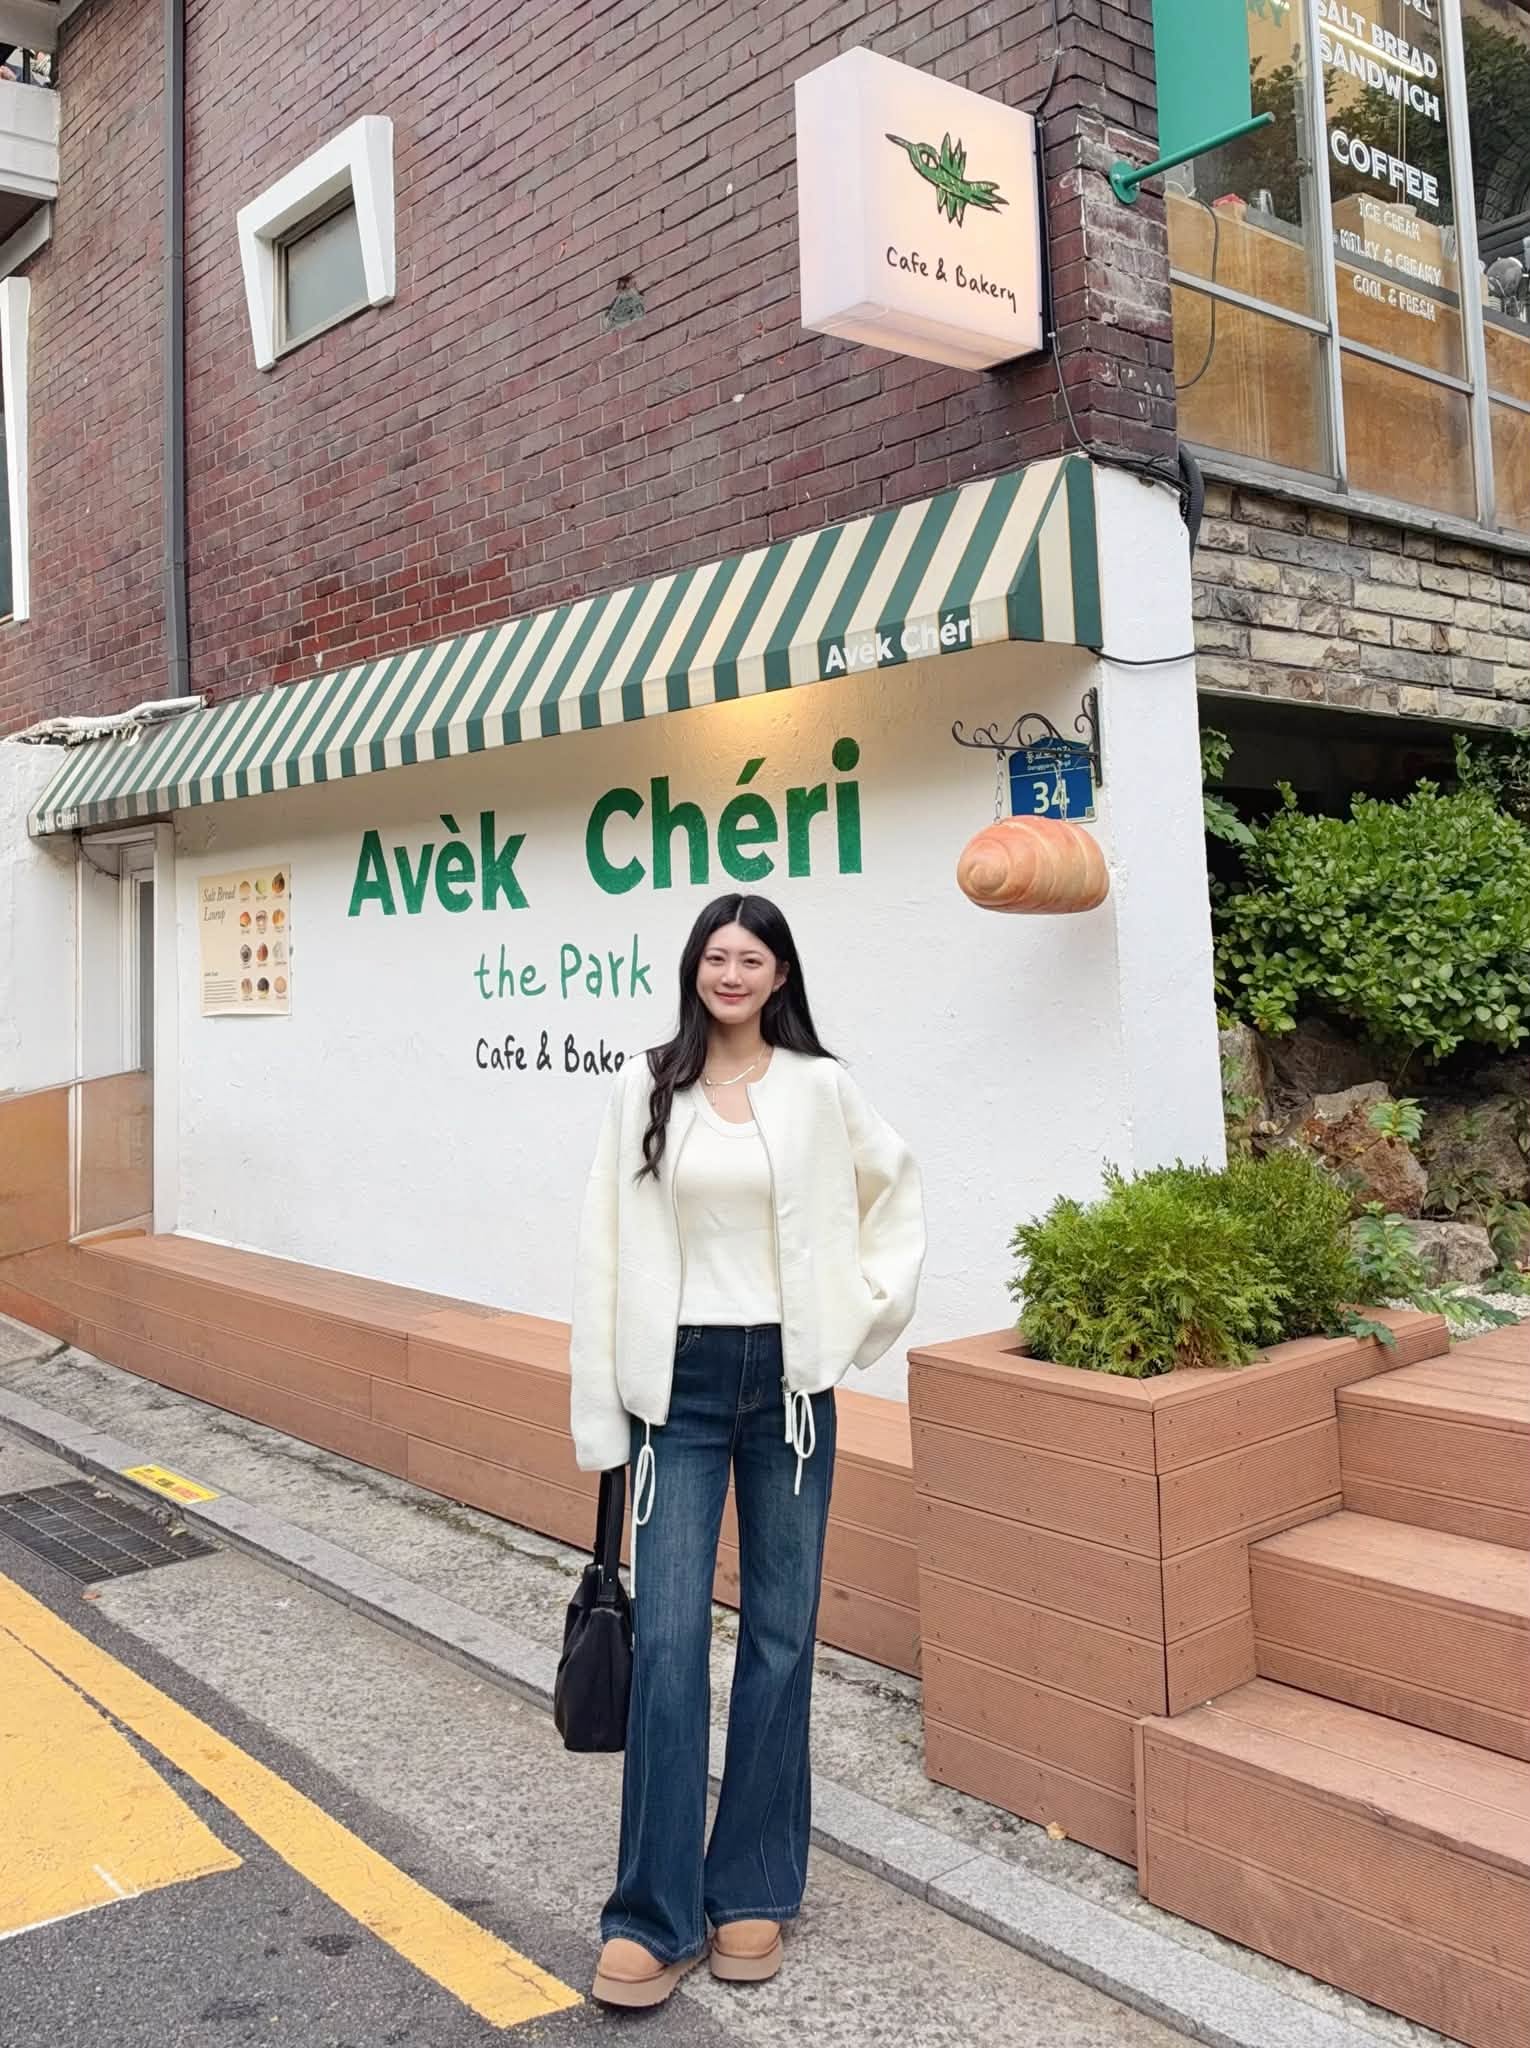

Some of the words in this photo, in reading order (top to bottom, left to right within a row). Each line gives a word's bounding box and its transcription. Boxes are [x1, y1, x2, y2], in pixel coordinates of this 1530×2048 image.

[1318, 0, 1365, 38] SALT
[1371, 23, 1437, 79] BREAD
[1319, 33, 1440, 122] SANDWICH
[1331, 130, 1439, 207] COFFEE
[1358, 197, 1381, 225] ICE
[886, 246, 928, 276] Cafe
[936, 257, 947, 282] &
[956, 264, 1016, 314] Bakery
[1384, 248, 1393, 268] &
[1353, 274, 1385, 304] COOL
[1387, 288, 1397, 307] &
[1399, 291, 1436, 322] FRESH
[825, 632, 894, 673] Avèk
[900, 613, 979, 653] Chéri
[348, 811, 530, 917] Avèk
[586, 737, 863, 895] Chéri
[1033, 778, 1070, 814] 34
[473, 943, 546, 999] the
[561, 933, 652, 998] Park
[476, 1034, 527, 1070] Cafe
[536, 1030, 552, 1070] &
